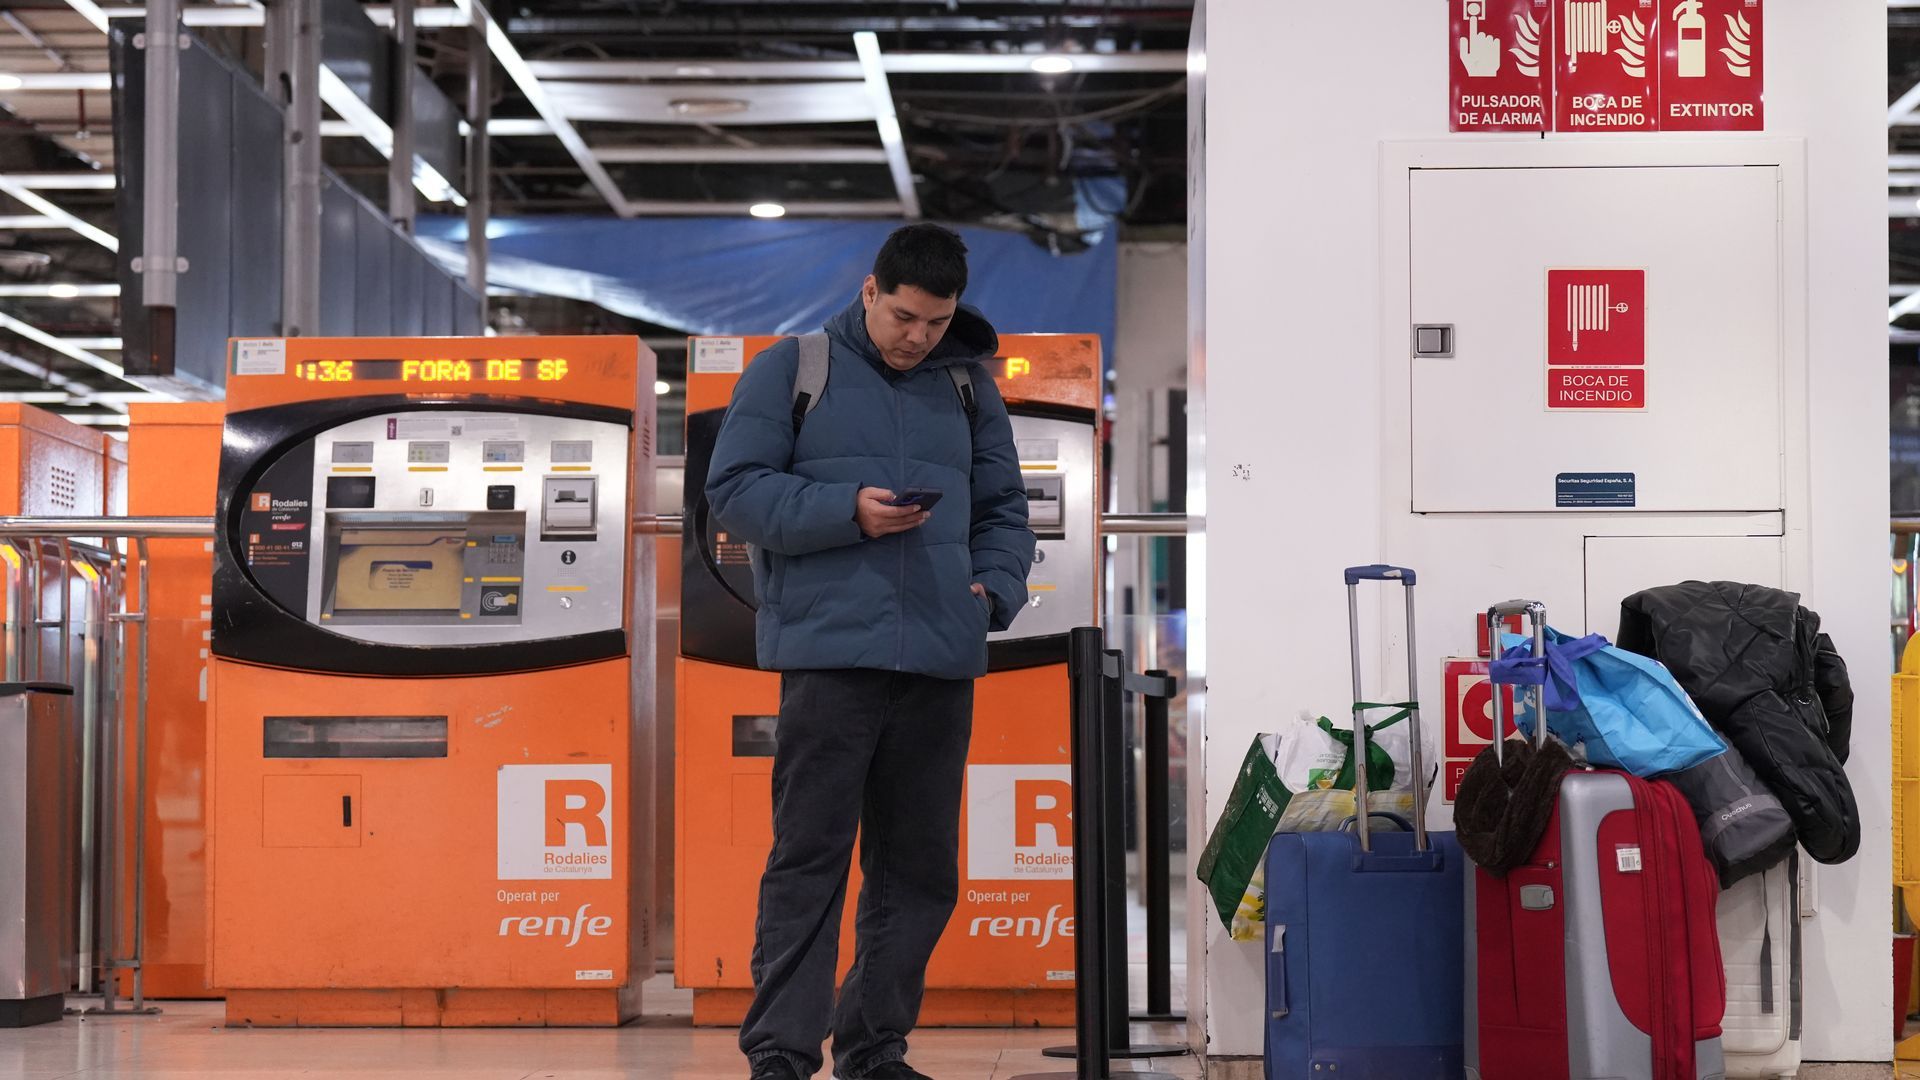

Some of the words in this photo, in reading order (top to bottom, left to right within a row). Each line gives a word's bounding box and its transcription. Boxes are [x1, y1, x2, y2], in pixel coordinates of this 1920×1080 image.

[1462, 95, 1541, 108] PULSADOR
[1573, 96, 1618, 109] BOCA
[1622, 96, 1643, 109] DE
[1670, 104, 1754, 117] EXTINTOR
[1459, 113, 1479, 126] DE
[1482, 113, 1543, 126] ALARMA
[1570, 114, 1645, 127] INCENDIO
[402, 360, 471, 381] FORA
[486, 359, 522, 381] DE
[1563, 375, 1605, 386] BOCA
[1608, 375, 1629, 386] DE
[1559, 390, 1633, 401] INCENDIO
[272, 499, 308, 507] Rodalies
[544, 779, 607, 846] R
[1015, 779, 1073, 846] R
[544, 853, 607, 865] Rodalies
[555, 866, 592, 874] Catalunya
[1014, 866, 1024, 874] de
[1025, 866, 1064, 875] Catalunya
[497, 890, 537, 904] Operat
[541, 891, 560, 905] per
[967, 890, 1007, 904] Operat
[1011, 891, 1031, 905] per
[498, 904, 613, 948] renfe
[969, 904, 1075, 948] renfe
